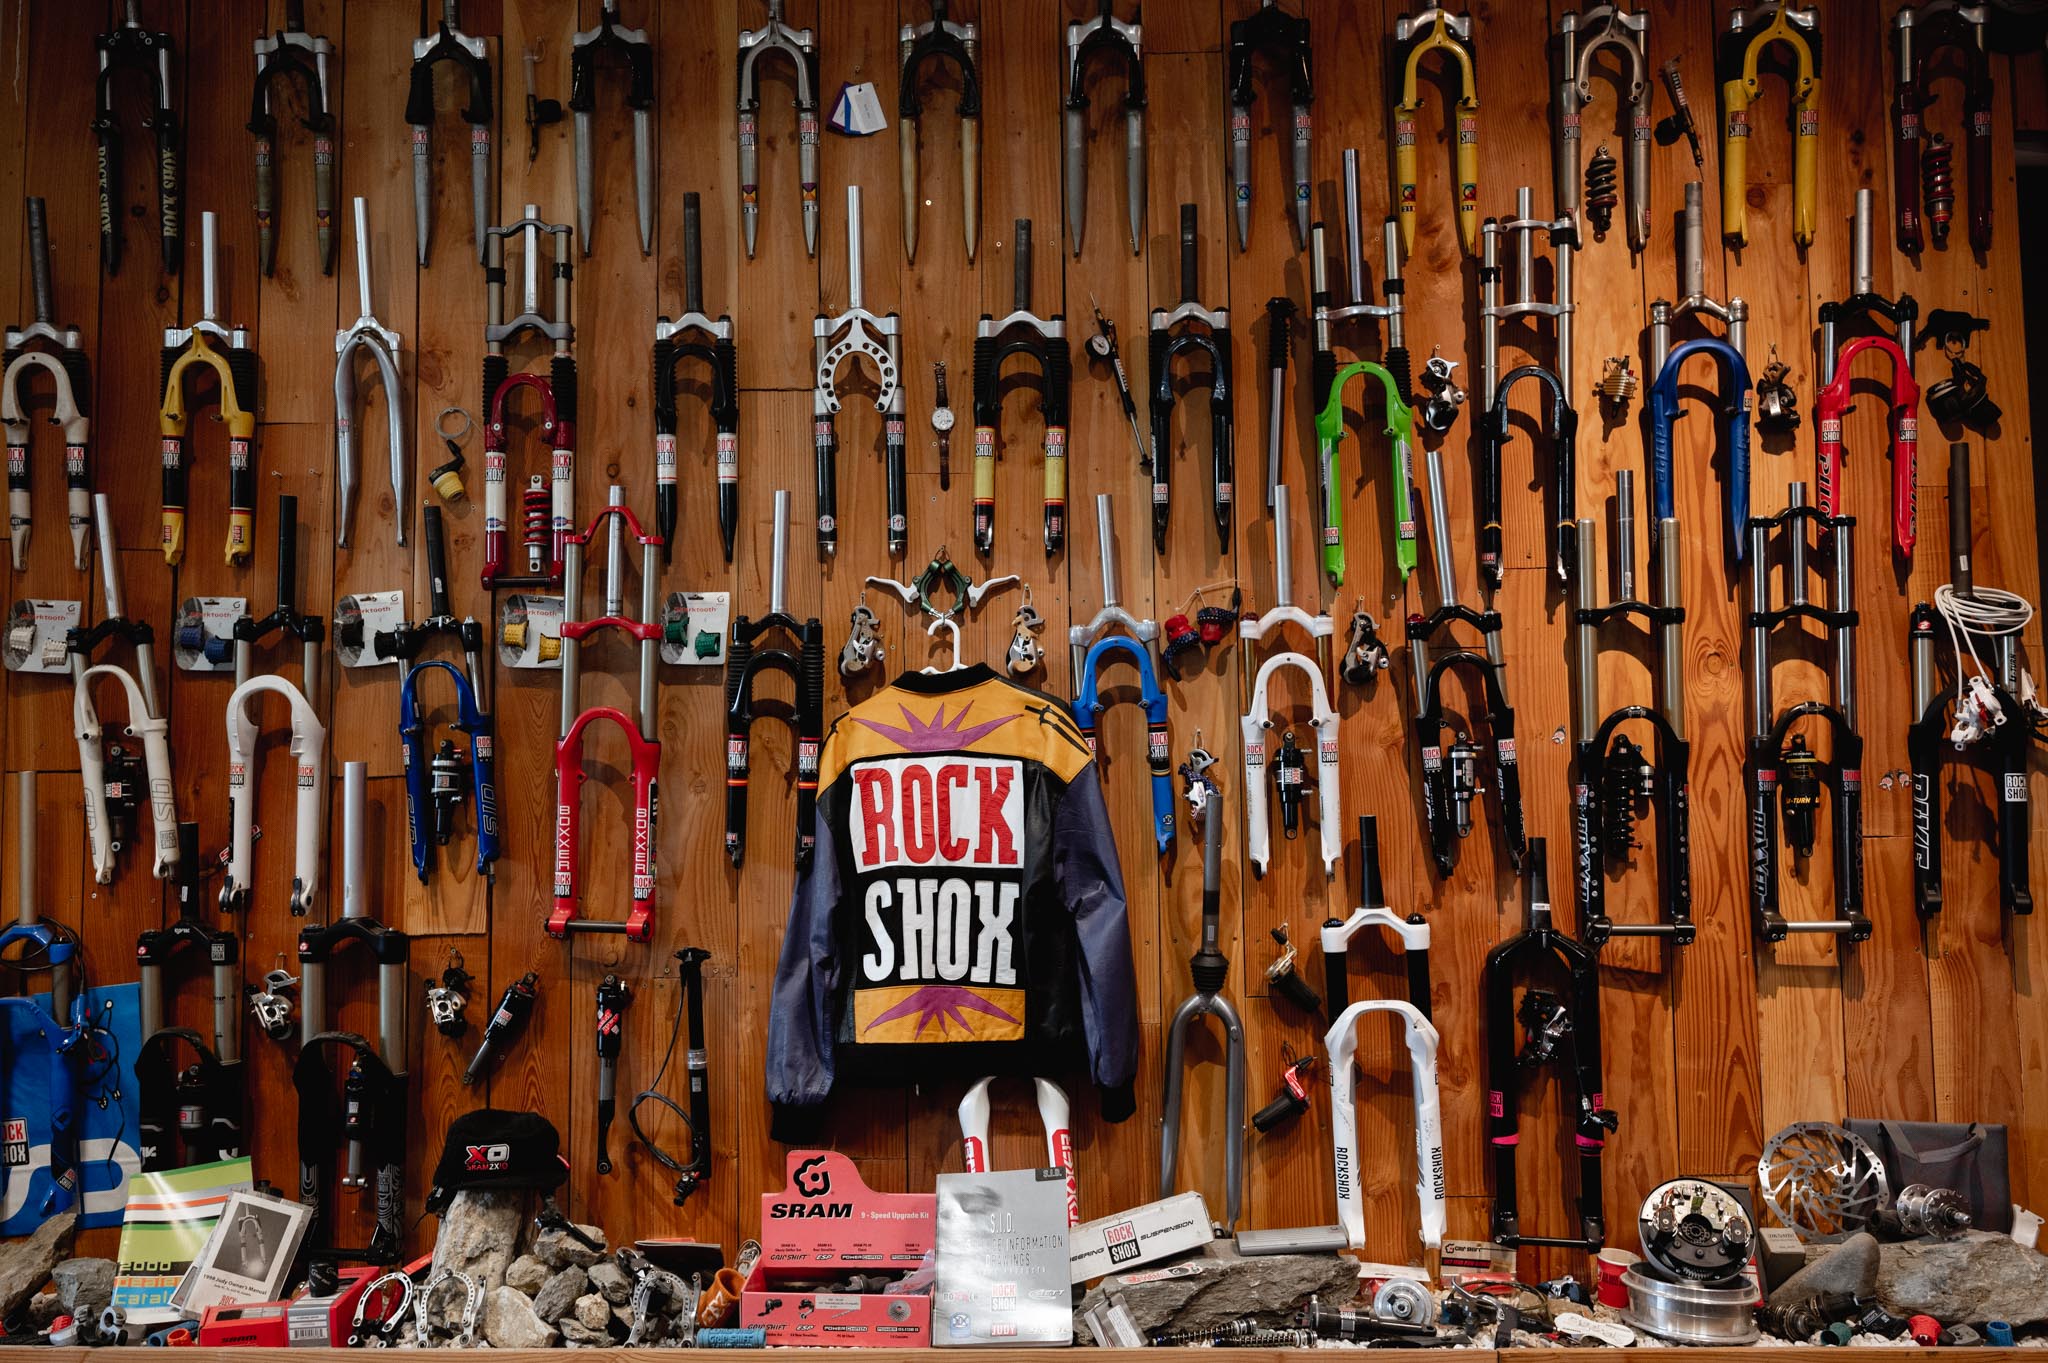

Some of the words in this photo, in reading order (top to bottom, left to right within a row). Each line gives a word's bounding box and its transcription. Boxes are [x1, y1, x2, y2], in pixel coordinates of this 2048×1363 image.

[1822, 421, 1839, 432] ROCK
[7, 447, 24, 460] OCK
[67, 447, 84, 459] OCK
[975, 444, 992, 457] SHOX
[2008, 653, 2017, 683] U-TURN
[1150, 732, 1168, 745] ROCK
[1150, 745, 1168, 759] SHOX
[1246, 743, 1261, 754] ROCK
[1321, 742, 1338, 753] ROCK
[1423, 747, 1439, 759] ROCK
[1246, 754, 1262, 764] SHOX
[1322, 753, 1338, 763] SHOX
[1424, 758, 1441, 770] SHOX
[151, 777, 174, 823] SID
[483, 782, 499, 837] SID
[854, 763, 1019, 867] ROCK
[560, 806, 571, 872] BOXXER
[635, 808, 647, 873] BOXXER
[862, 877, 1020, 985] SHOX
[1043, 1169, 1062, 1178] S.I.D.
[1336, 1147, 1350, 1201] ROCKSHOX
[1432, 1146, 1444, 1200] ROCKSHOX
[770, 1203, 854, 1219] SRAM
[871, 1212, 890, 1220] Speed
[891, 1212, 918, 1221] Upgrade
[919, 1211, 929, 1219] Kit
[990, 1212, 1016, 1233] S.I.D.
[1107, 1223, 1134, 1245] ROCK
[1140, 1219, 1195, 1241] SUSPENSION
[1111, 1243, 1138, 1262] SHOX
[120, 1261, 171, 1272] 2000
[992, 1284, 1017, 1297] ROCK
[992, 1297, 1017, 1310] SHOX
[992, 1324, 1017, 1336] JUDY
